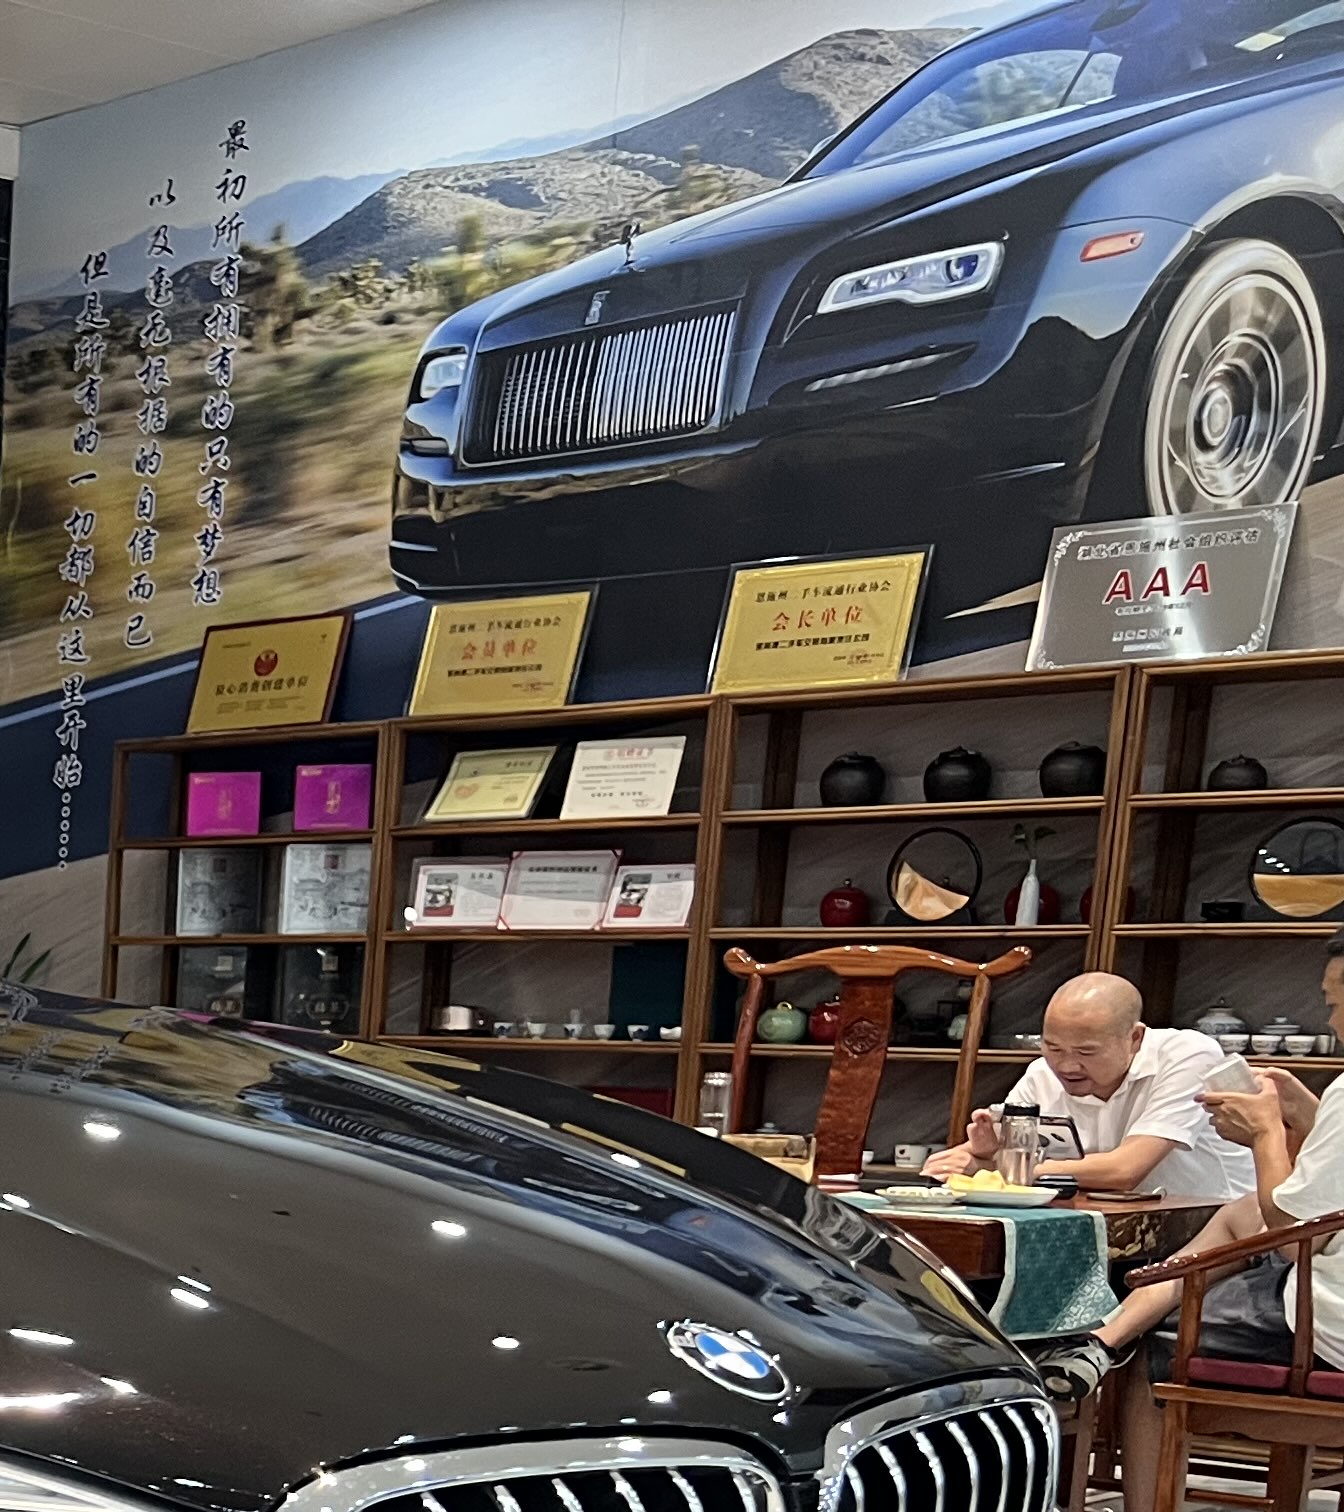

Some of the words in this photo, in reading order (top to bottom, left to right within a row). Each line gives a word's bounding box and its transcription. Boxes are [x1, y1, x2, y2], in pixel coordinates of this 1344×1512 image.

[1102, 561, 1211, 605] AAA
[771, 605, 864, 631] 会长单位
